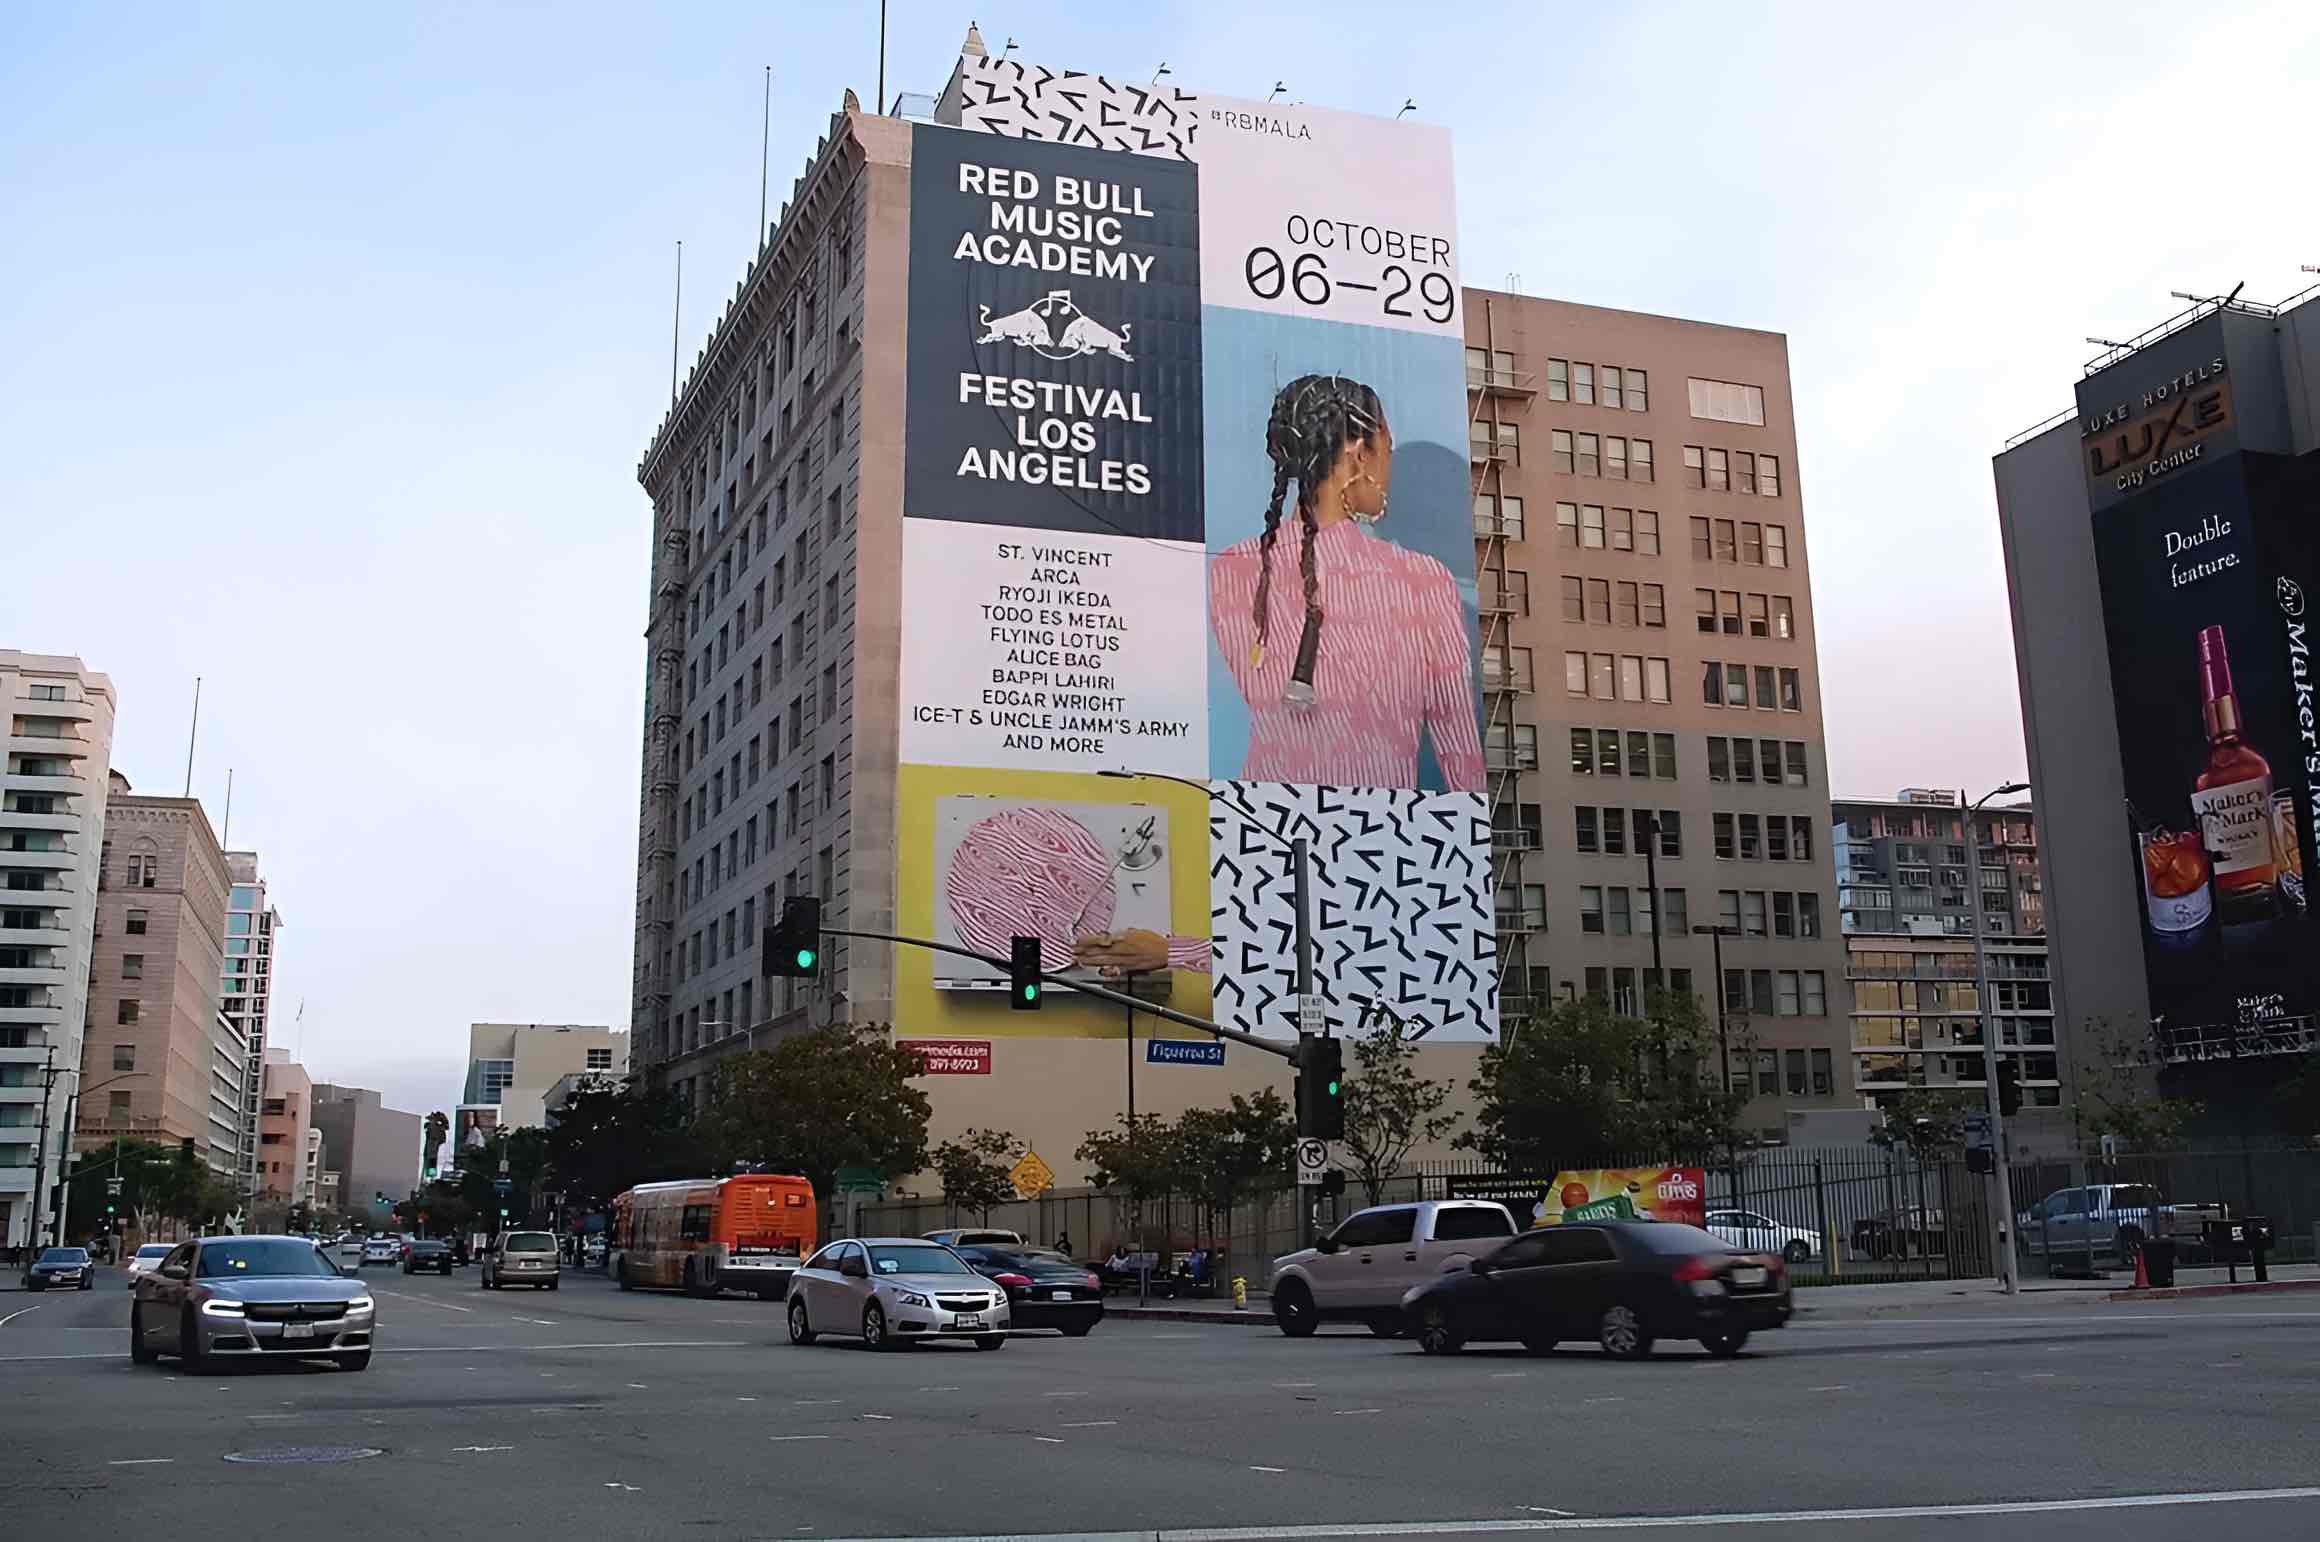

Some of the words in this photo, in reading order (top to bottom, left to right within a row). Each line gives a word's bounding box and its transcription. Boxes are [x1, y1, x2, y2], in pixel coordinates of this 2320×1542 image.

[958, 162, 1040, 200] RED
[1055, 176, 1154, 218] BULL
[990, 202, 1122, 246] MUSIC
[1287, 214, 1450, 267] OCTOBER
[952, 231, 1155, 283] ACADEMY
[959, 372, 1153, 423] FESTIVAL
[2143, 357, 2225, 409] HOTELS
[1016, 415, 1096, 450] LOS
[2090, 390, 2226, 476] LUXE
[956, 446, 1152, 495] ANGELES
[2116, 469, 2145, 490] City
[2149, 444, 2202, 476] Center
[2164, 514, 2232, 558] Double
[998, 544, 1025, 560] ST.
[1032, 547, 1113, 567] VINCENT
[1030, 568, 1081, 585] ARCA
[999, 586, 1051, 604] RYOJI
[1058, 590, 1112, 608] IKEDA
[980, 604, 1033, 624] TODO
[1040, 610, 1063, 626] ES
[1069, 613, 1129, 631] METAL
[991, 627, 1054, 646] FLYING
[1061, 632, 1120, 651] LOTUS
[1007, 649, 1059, 666] ALICE
[1065, 653, 1101, 669] BAG
[993, 669, 1048, 686] BAPPI
[1055, 673, 1115, 690] LAHIRI
[983, 690, 1046, 708] EDGAR
[1052, 694, 1126, 713] WRIGHT
[914, 706, 964, 724] ICE-T
[990, 711, 1052, 729] UNCLE
[1058, 716, 1131, 735] JAMM'S
[1137, 720, 1190, 737] ARMY
[1002, 734, 1043, 751] AND
[1050, 738, 1105, 754] MORE
